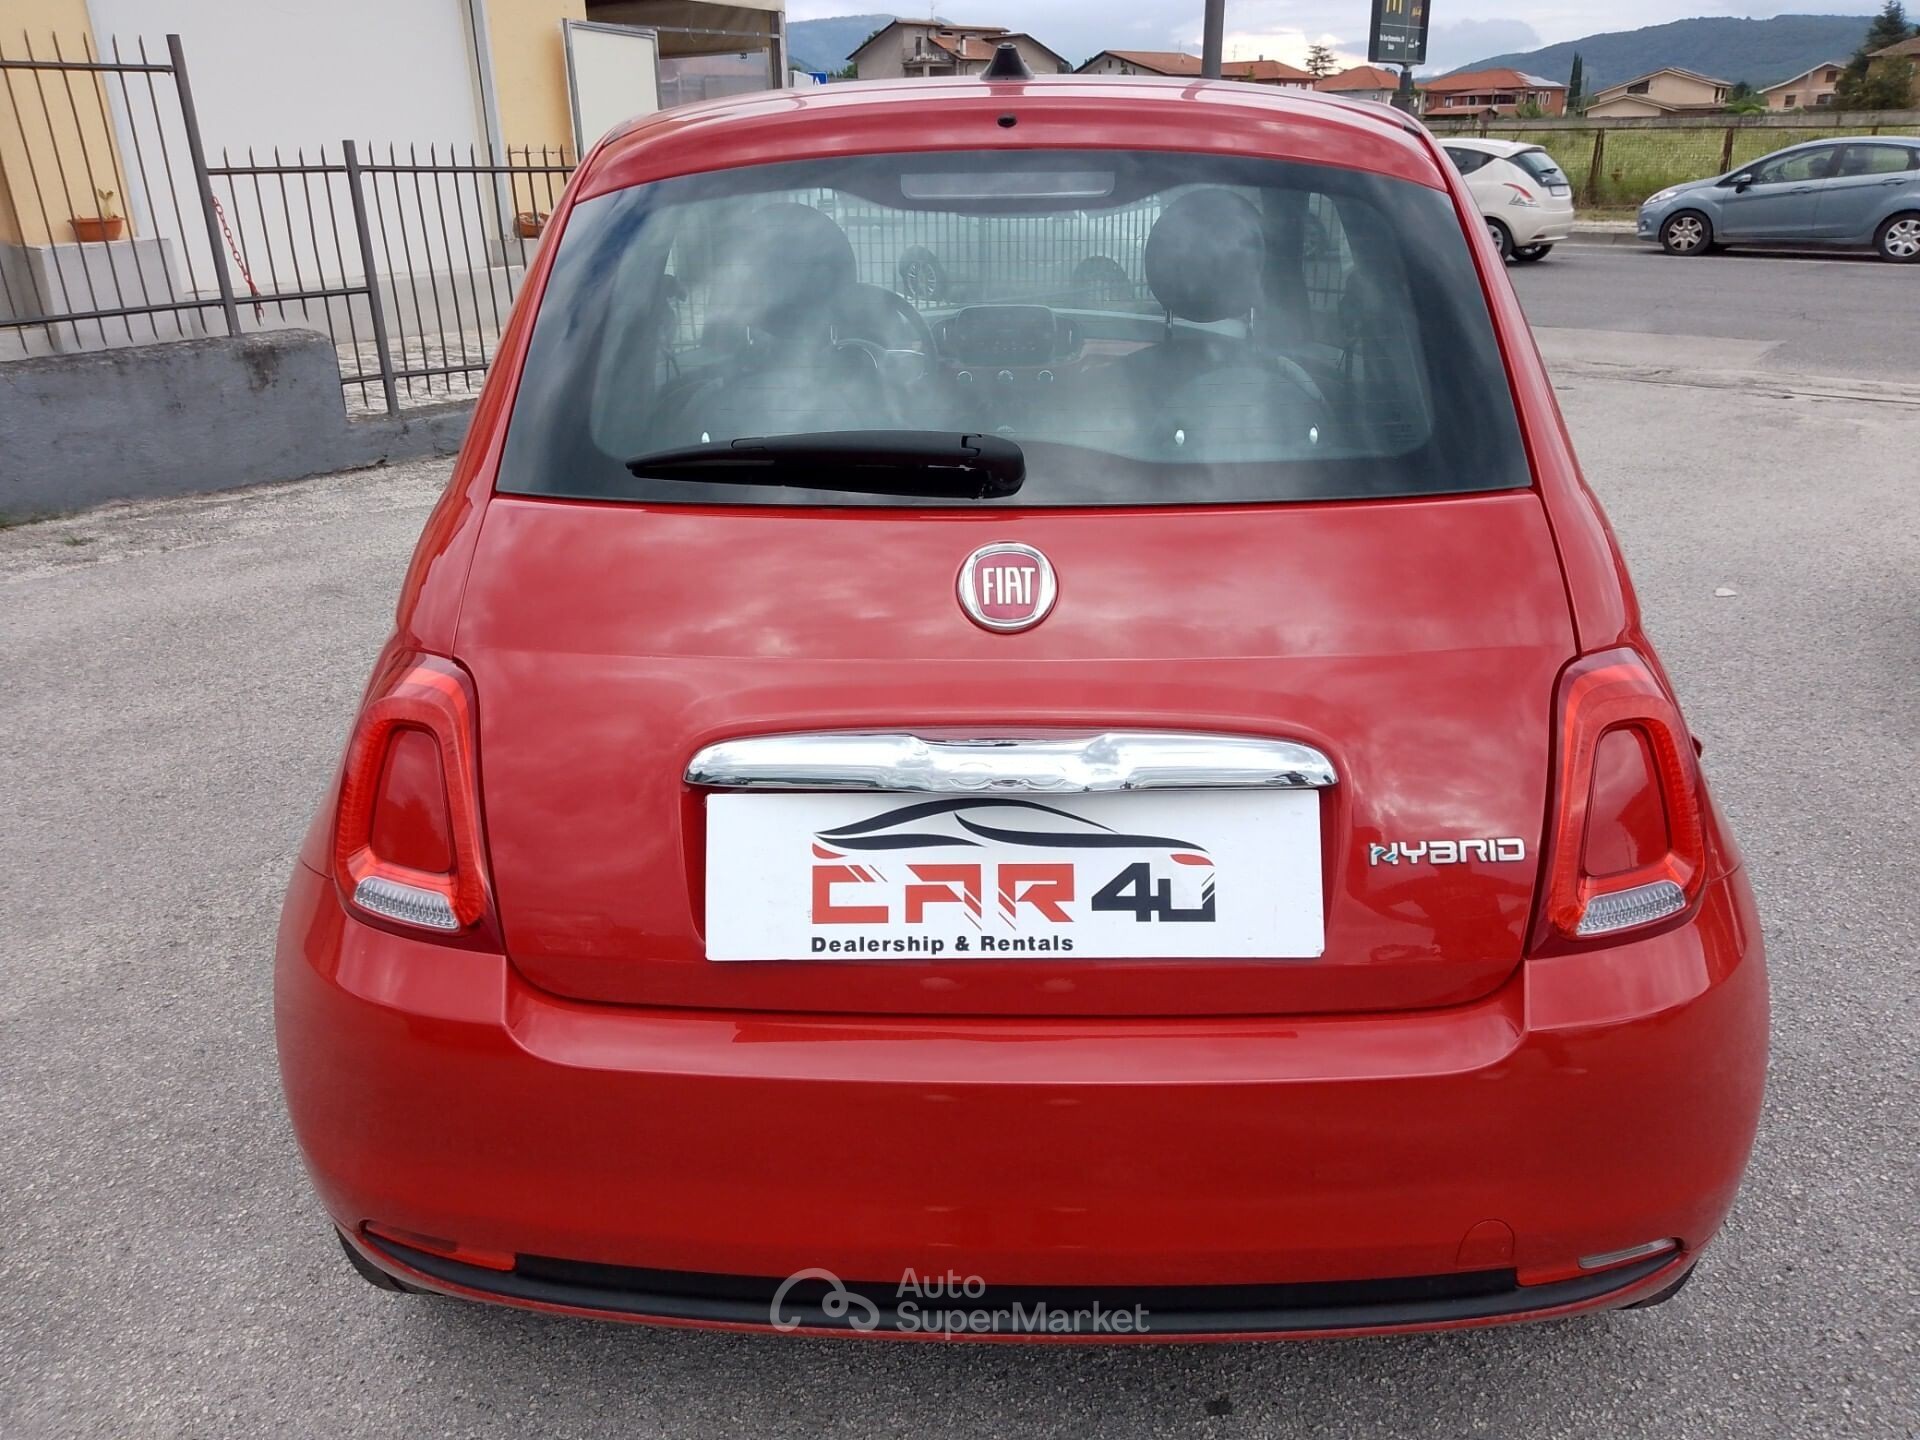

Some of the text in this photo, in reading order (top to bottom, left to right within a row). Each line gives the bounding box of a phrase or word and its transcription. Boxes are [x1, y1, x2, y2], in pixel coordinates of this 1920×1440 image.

[982, 566, 1035, 605] FIAT
[1369, 838, 1525, 866] HYBRID
[811, 935, 1074, 955] Dealership & Rentals
